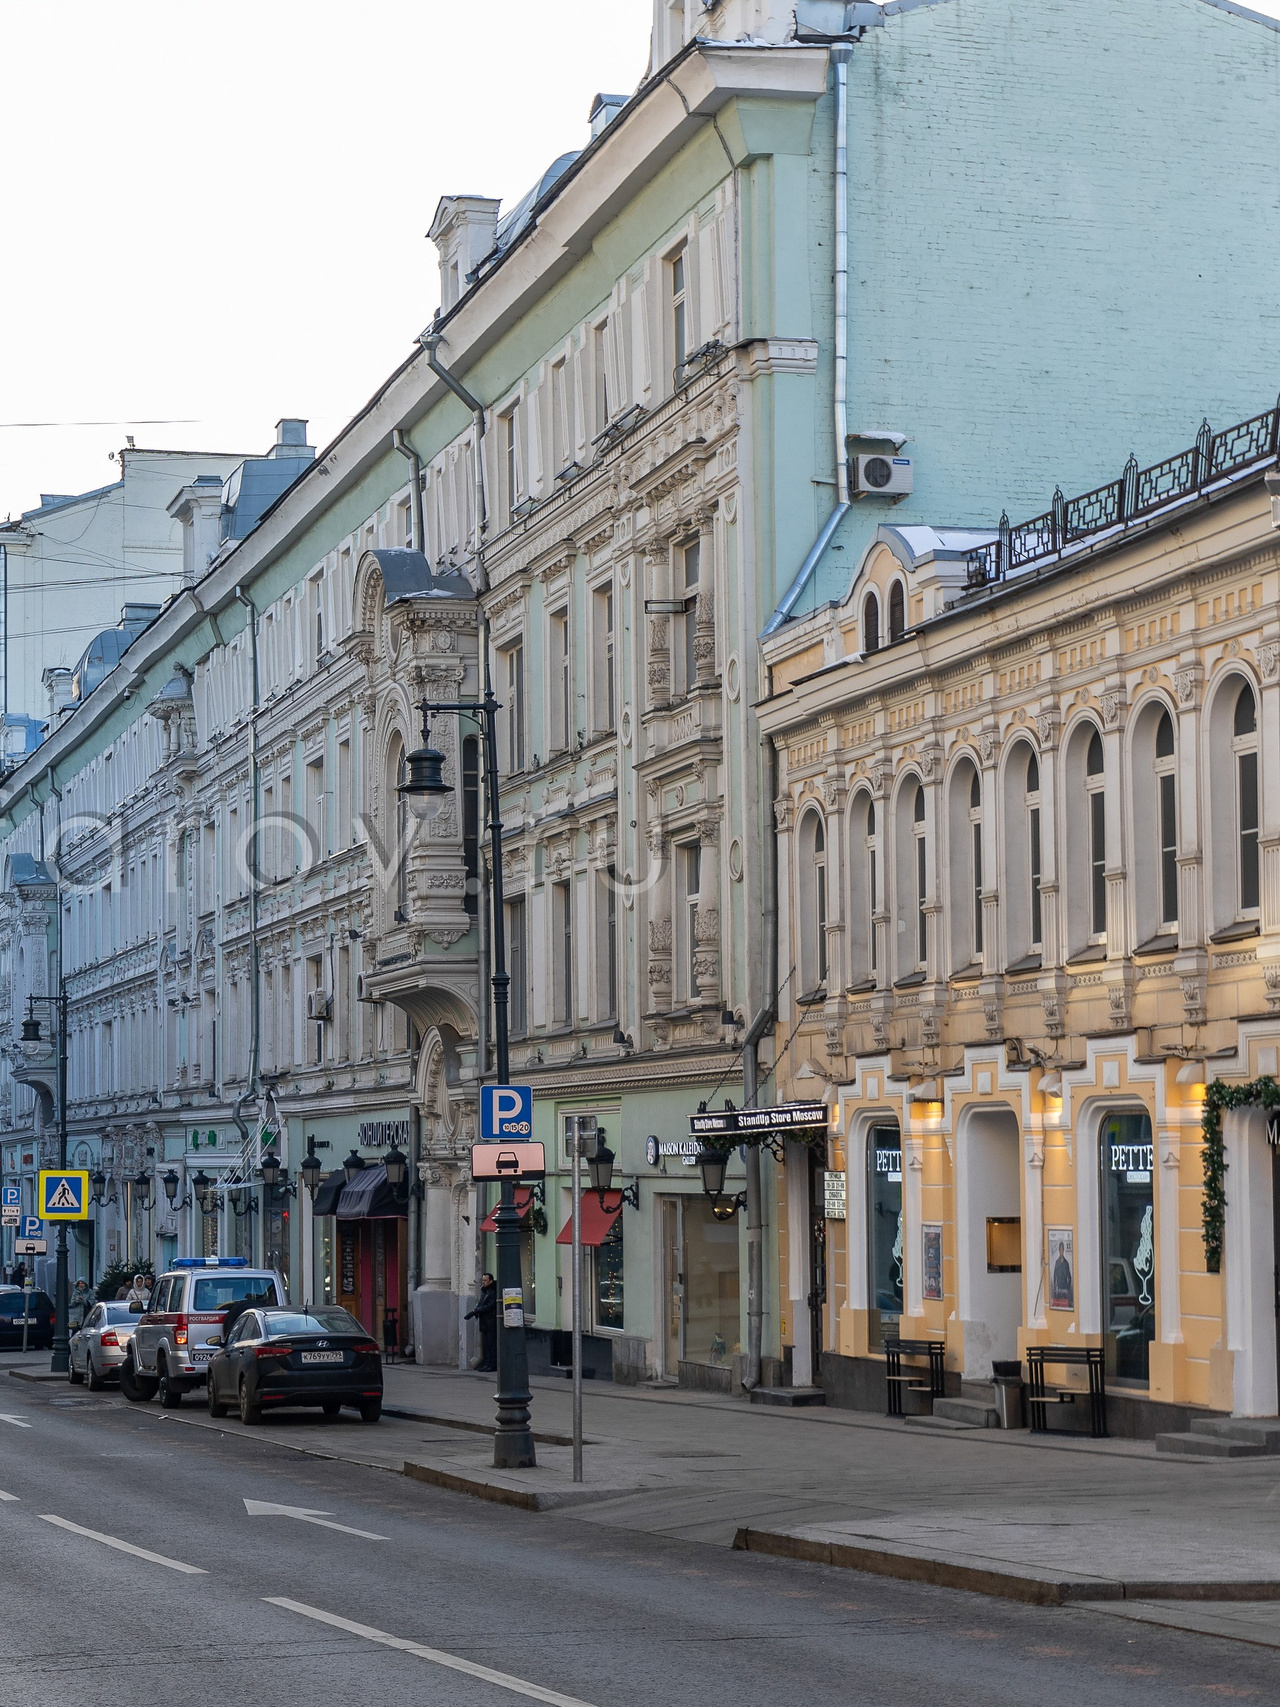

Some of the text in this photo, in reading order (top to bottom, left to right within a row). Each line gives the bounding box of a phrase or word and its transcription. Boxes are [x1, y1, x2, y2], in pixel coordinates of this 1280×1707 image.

[492, 1089, 523, 1135] P
[738, 1110, 823, 1127] StandUp Store Moscow
[358, 1121, 410, 1147] КОНДИТЕРСКА
[1265, 1119, 1280, 1145] M
